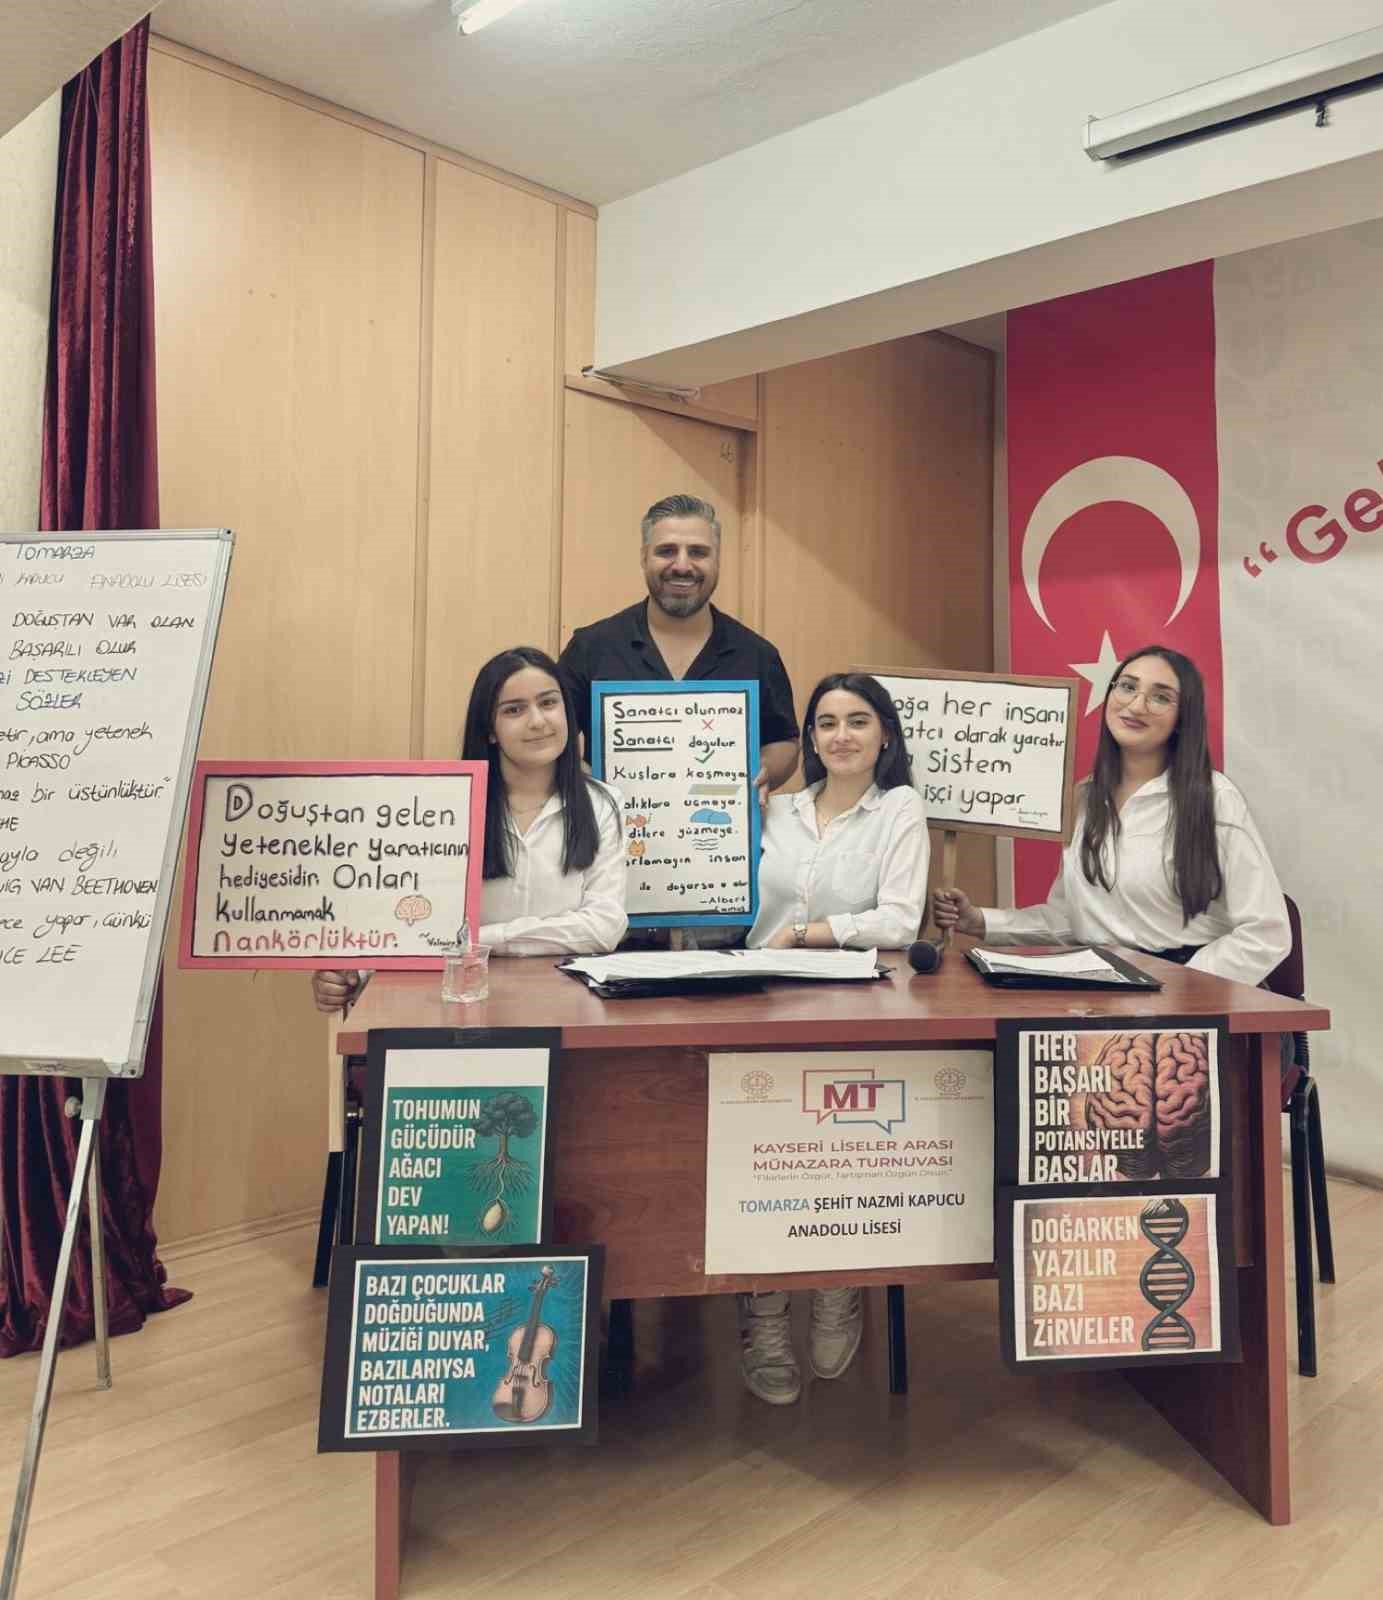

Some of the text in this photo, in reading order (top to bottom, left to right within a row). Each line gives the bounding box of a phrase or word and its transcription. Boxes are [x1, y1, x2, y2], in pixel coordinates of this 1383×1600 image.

[107, 613, 137, 629] VAR
[95, 639, 137, 655] OLUR
[894, 691, 1065, 725] oğa her insanı
[73, 721, 153, 756] yetenek
[954, 724, 1007, 744] olarak
[31, 780, 56, 804] bir
[960, 788, 1026, 816] yapar
[224, 783, 456, 828] Doğuştan gelen
[31, 876, 66, 894] VAN
[71, 875, 158, 896] BEETHOVEN
[333, 864, 420, 891] Onları
[36, 944, 83, 964] LEE
[1033, 1033, 1078, 1062] HER
[1033, 1064, 1112, 1097] BAŞARI
[391, 1098, 481, 1121] TOHUMUN
[823, 1083, 885, 1110] MT
[1033, 1095, 1071, 1127] BİR
[390, 1123, 477, 1150] GÜCÜDÜR
[752, 1138, 953, 1155] KAYSERİ LİSELER ARASI
[1034, 1127, 1145, 1152] POTANSİYELLE
[388, 1152, 442, 1179] AĞACI
[752, 1155, 953, 1171] MÜNAZARA TURNUVASI
[387, 1185, 423, 1207] DEV
[738, 1192, 966, 1214] TOMARZA ŞEHİT NAZMİ KAPUCU
[386, 1213, 450, 1236] YAPAN!
[787, 1218, 902, 1239] ANADOLU LİSESİ
[1030, 1213, 1140, 1244] DOĞARKEN
[1031, 1247, 1118, 1278] YAZILIR
[365, 1272, 506, 1302] BAZI ÇOCUKLAR
[1032, 1282, 1084, 1314] BAZI
[363, 1298, 485, 1325] DOĞDUĞUNDA
[361, 1326, 490, 1353] MÜZİĞİ DUYAR,
[359, 1357, 476, 1382] BAZILARIYSA
[357, 1383, 446, 1407] NOTALARI
[356, 1407, 451, 1432] EZBERLER.
